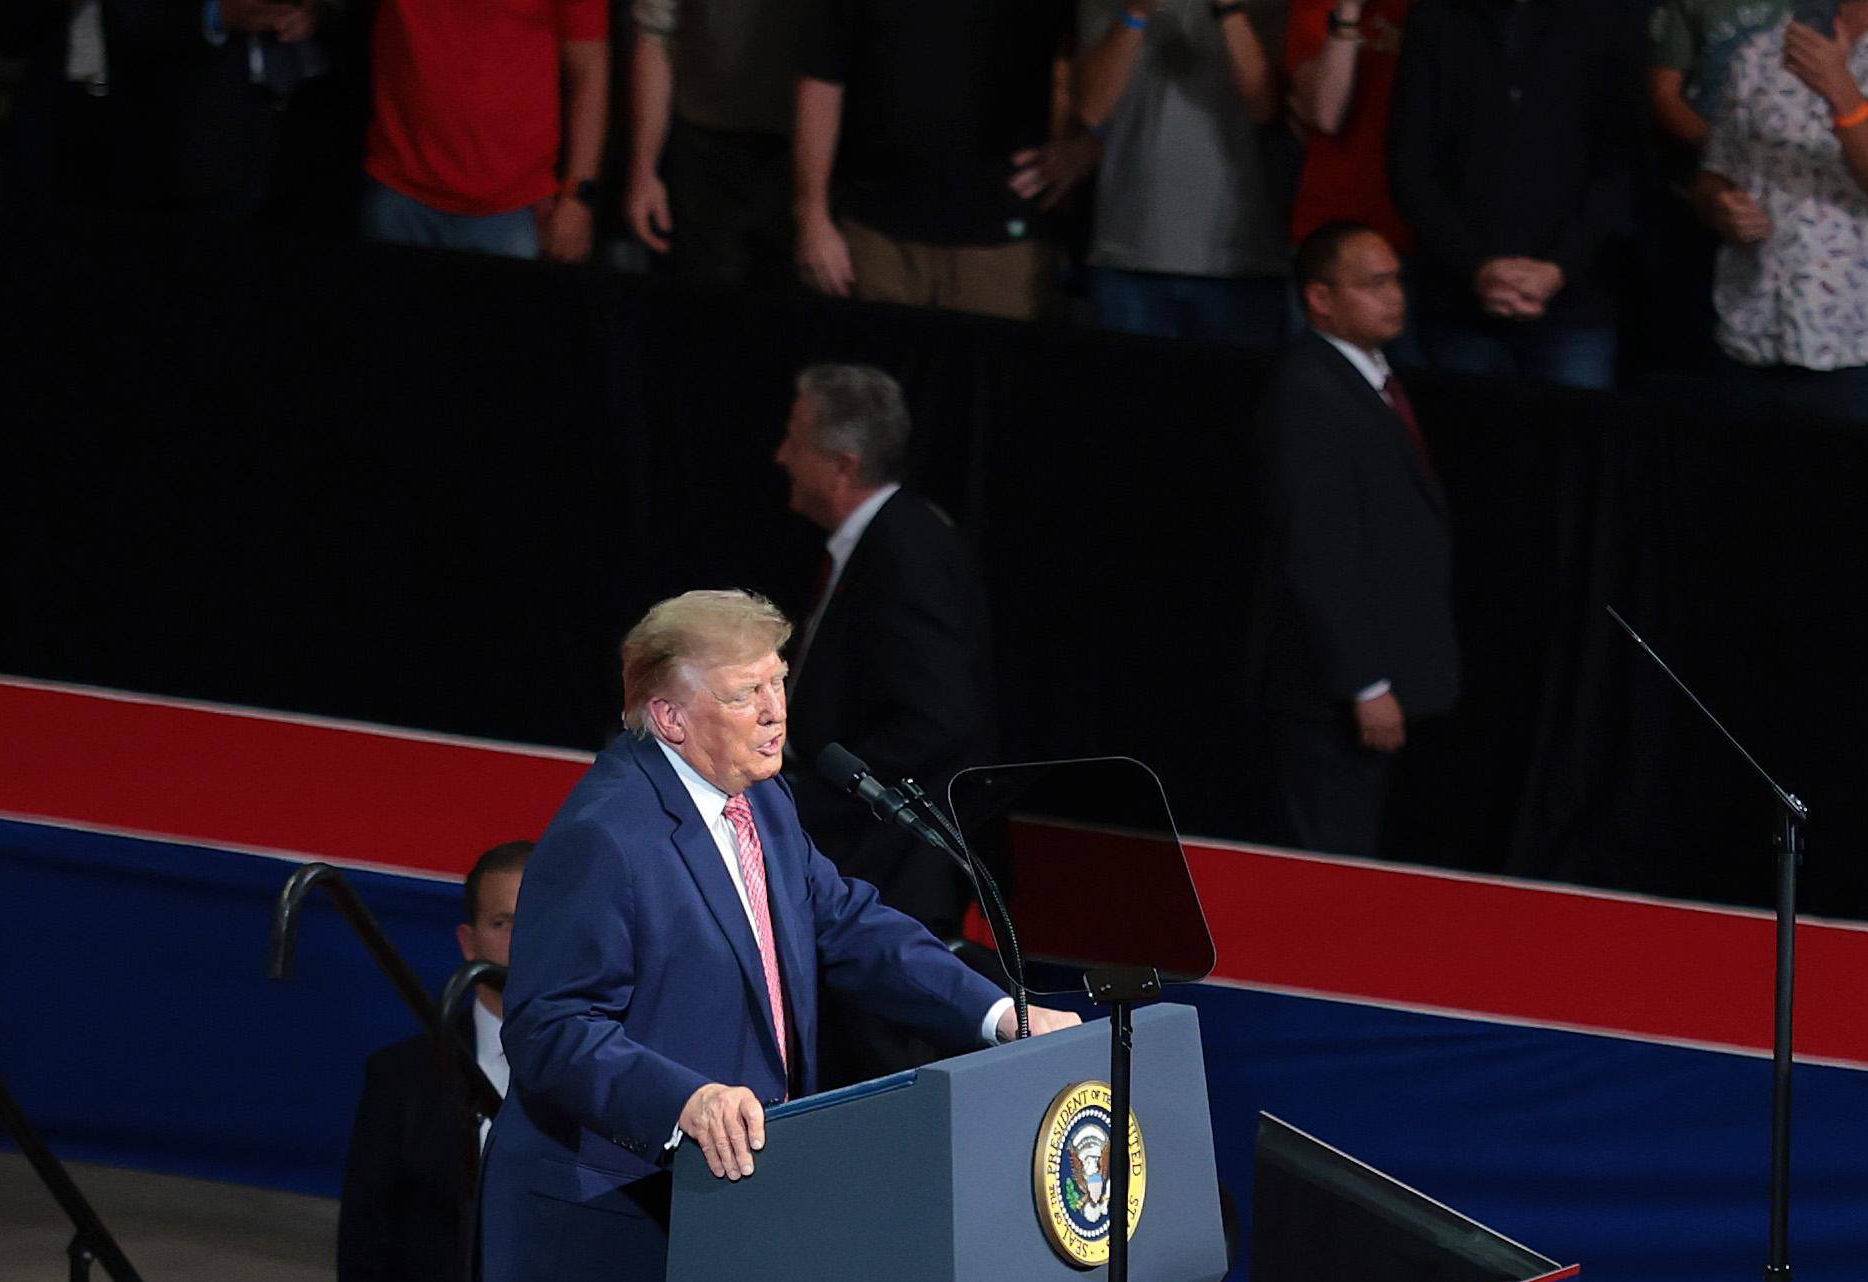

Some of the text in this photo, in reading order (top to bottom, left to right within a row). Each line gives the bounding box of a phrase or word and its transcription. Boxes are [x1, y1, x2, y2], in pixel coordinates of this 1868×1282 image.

[1090, 1089, 1101, 1100] OF
[1047, 1089, 1088, 1174] PRESIDENT
[1062, 1227, 1088, 1258] SEAL
